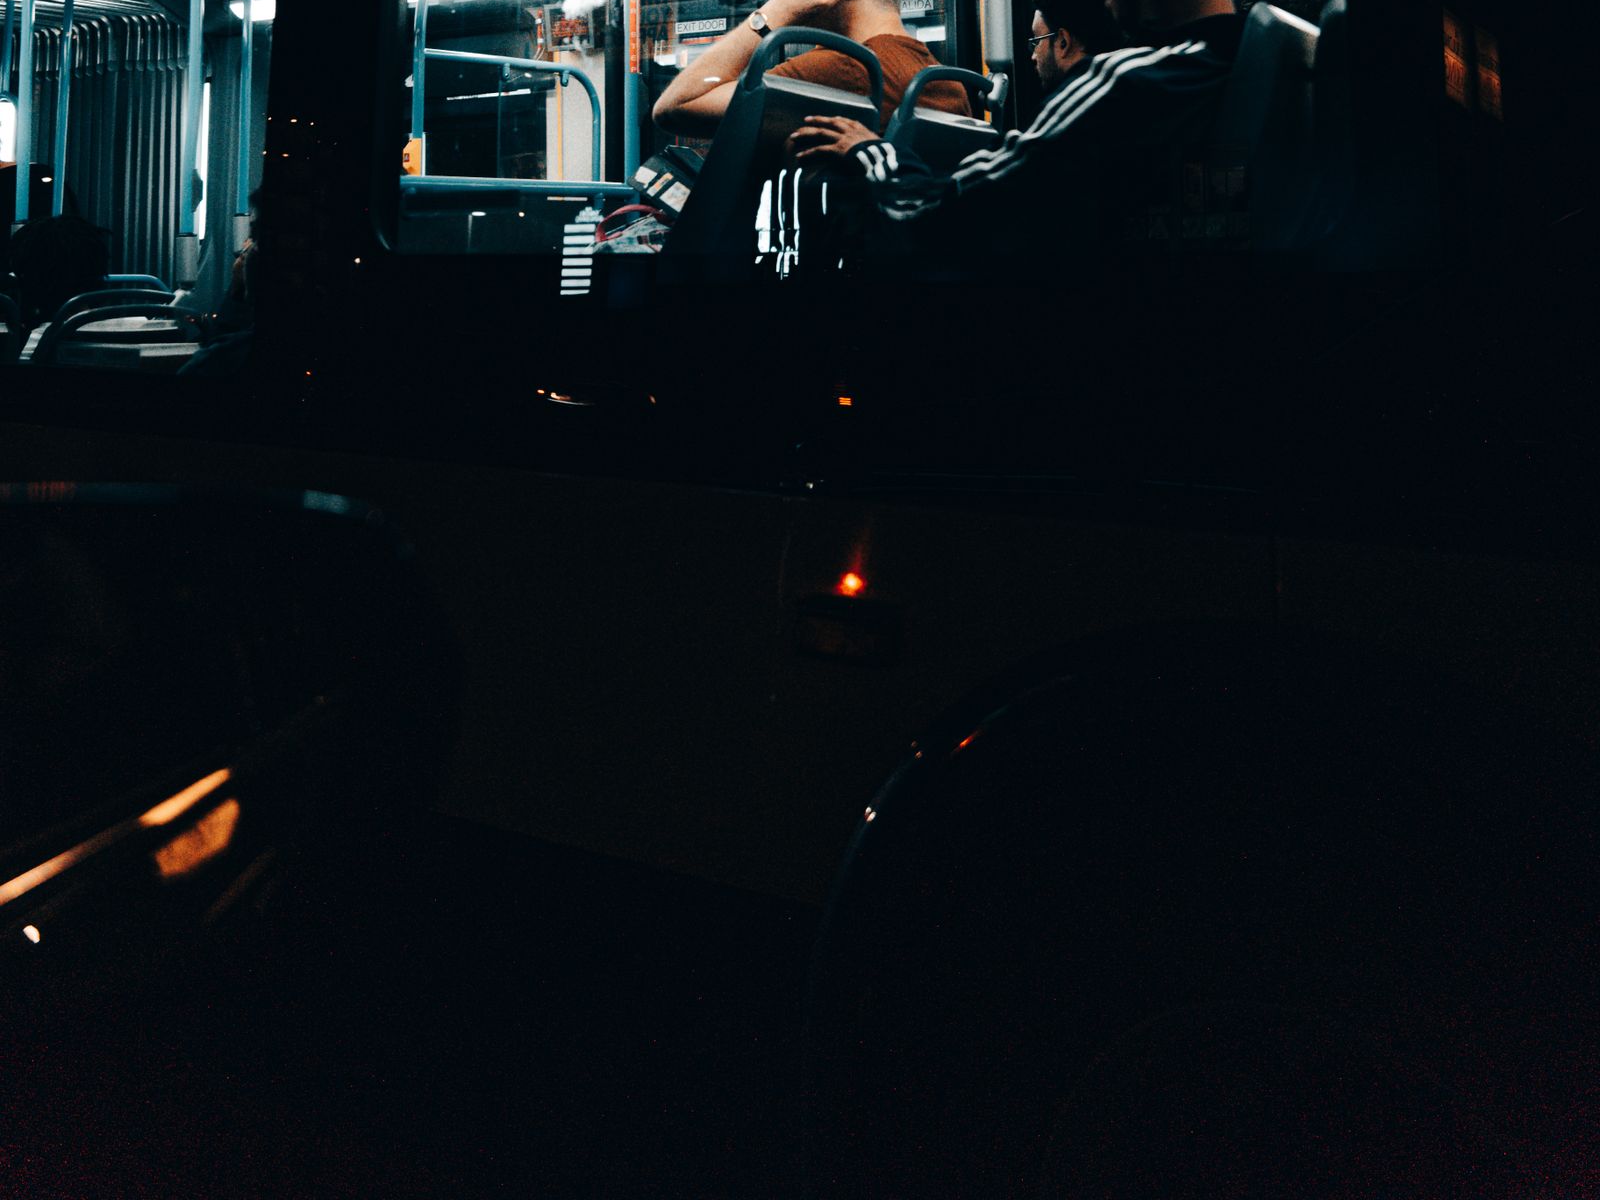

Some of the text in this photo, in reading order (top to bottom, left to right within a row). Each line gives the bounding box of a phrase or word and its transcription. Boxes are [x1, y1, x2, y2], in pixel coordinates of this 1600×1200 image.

[902, 0, 932, 9] ALIDA
[678, 19, 725, 33] EXIT DOOR
